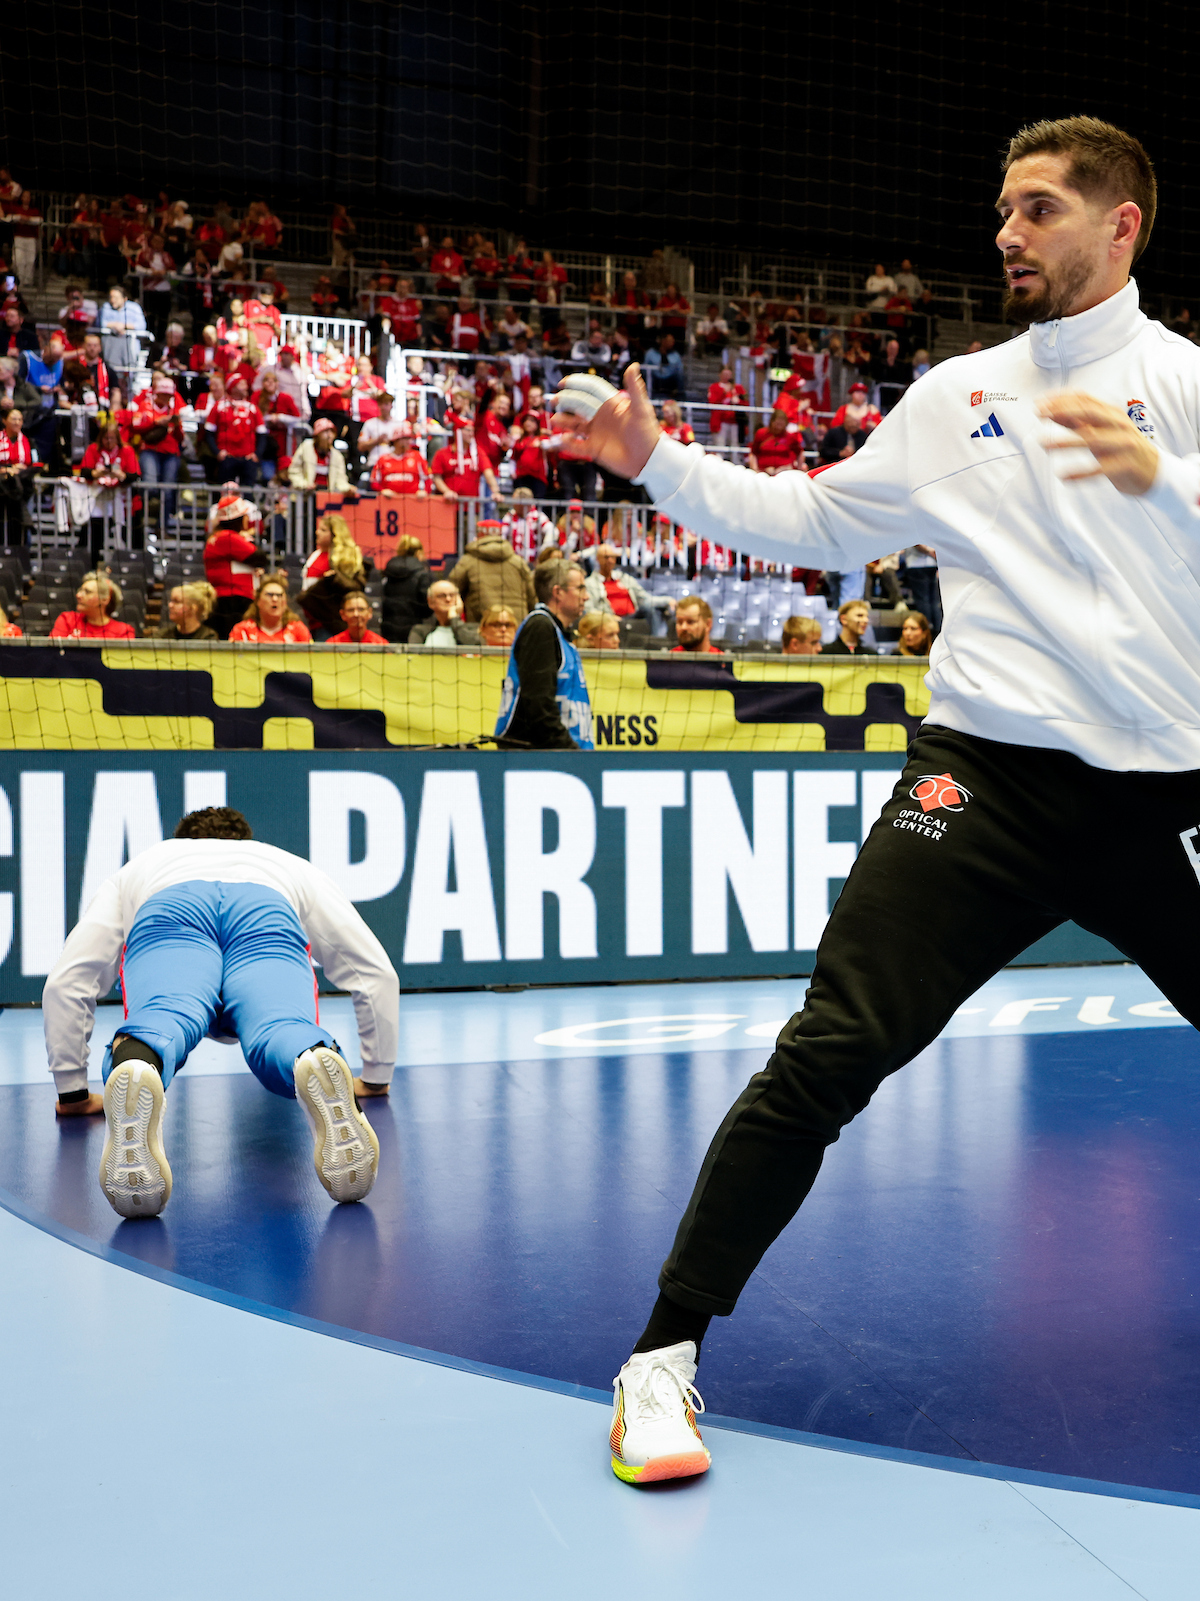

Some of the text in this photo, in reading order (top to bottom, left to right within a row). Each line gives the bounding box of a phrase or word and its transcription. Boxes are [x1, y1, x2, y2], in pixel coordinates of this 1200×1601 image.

[375, 510, 399, 536] L8
[592, 714, 659, 746] NESS
[892, 818, 943, 841] CENTER
[898, 809, 948, 832] OPTICAL
